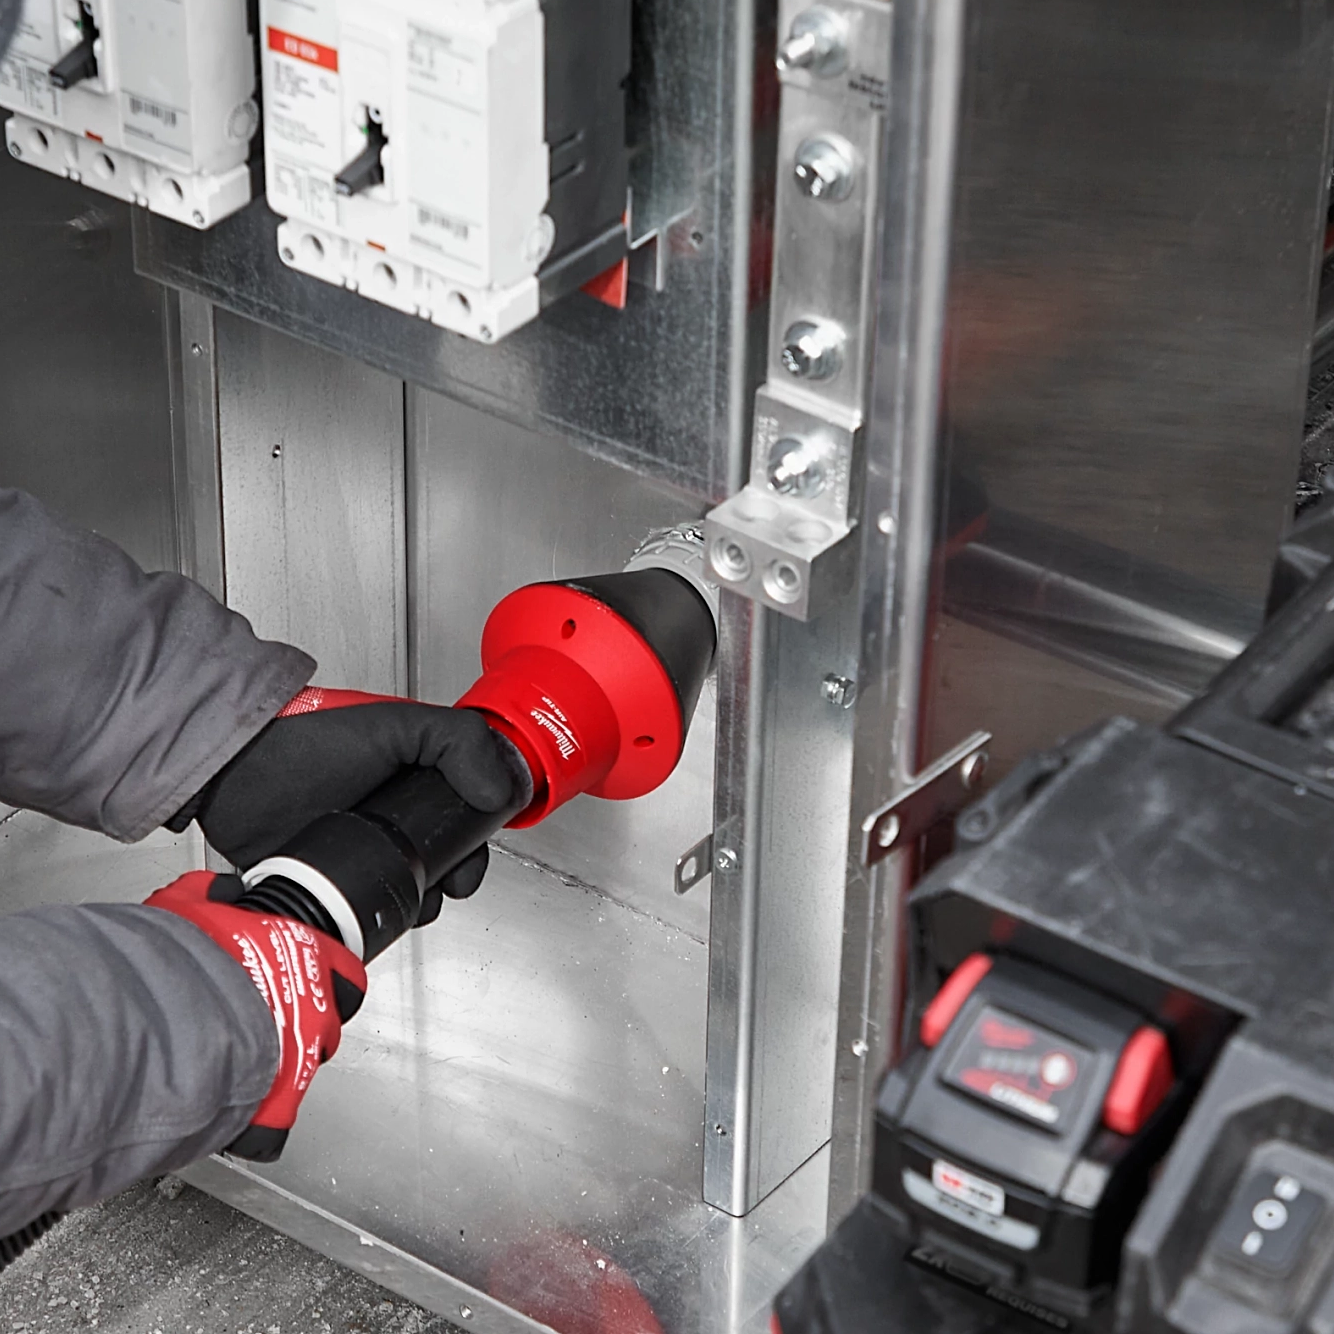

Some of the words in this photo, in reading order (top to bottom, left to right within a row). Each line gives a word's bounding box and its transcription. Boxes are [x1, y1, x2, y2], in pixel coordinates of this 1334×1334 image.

[541, 696, 567, 722] AIR-TIP
[530, 710, 575, 760] Milwaukee
[269, 929, 287, 972] LEVEL
[280, 975, 292, 1004] CUT
[310, 982, 327, 1013] CE
